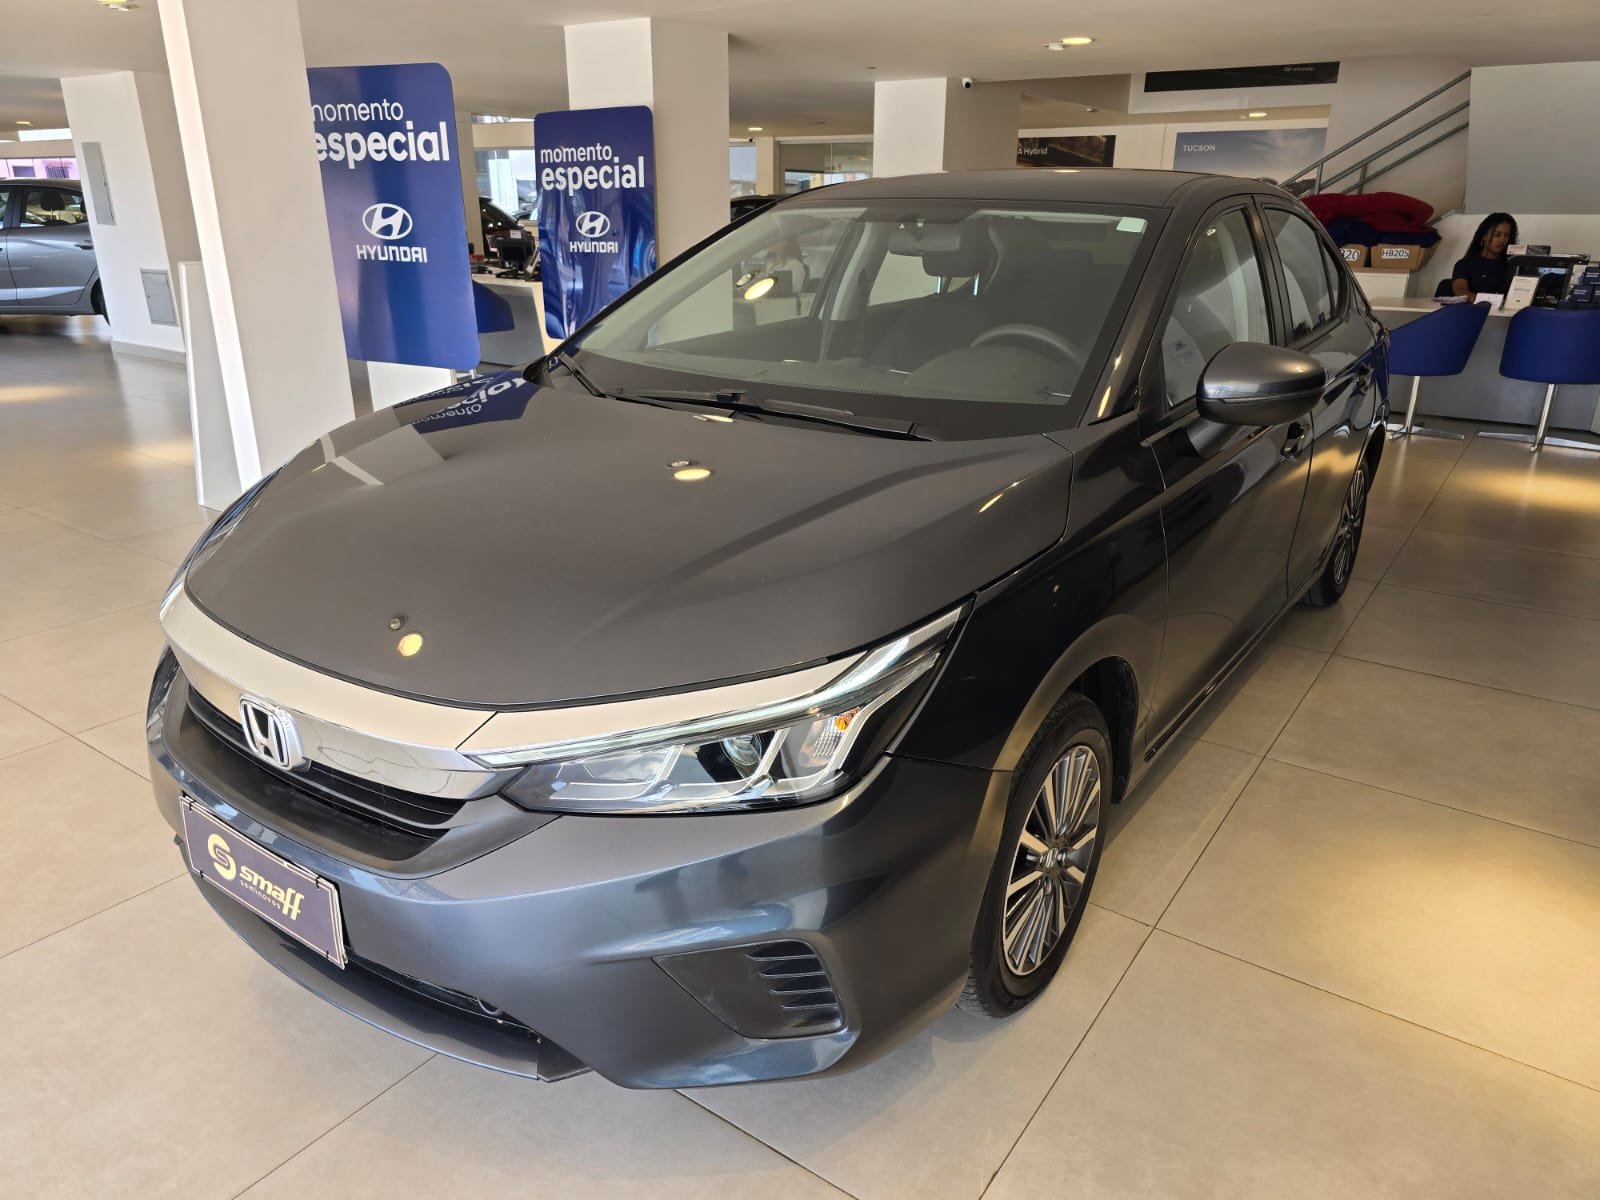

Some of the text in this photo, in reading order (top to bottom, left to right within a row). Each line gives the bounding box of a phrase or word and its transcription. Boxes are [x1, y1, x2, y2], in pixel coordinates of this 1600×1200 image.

[314, 120, 450, 169] especial
[541, 143, 612, 163] momento
[1024, 147, 1048, 157] Hybrid
[1183, 144, 1216, 152] TUCSON
[542, 156, 645, 196] especial
[356, 244, 428, 263] HYUNDAI
[569, 241, 618, 253] HYUNDAI
[240, 865, 305, 920] smaff
